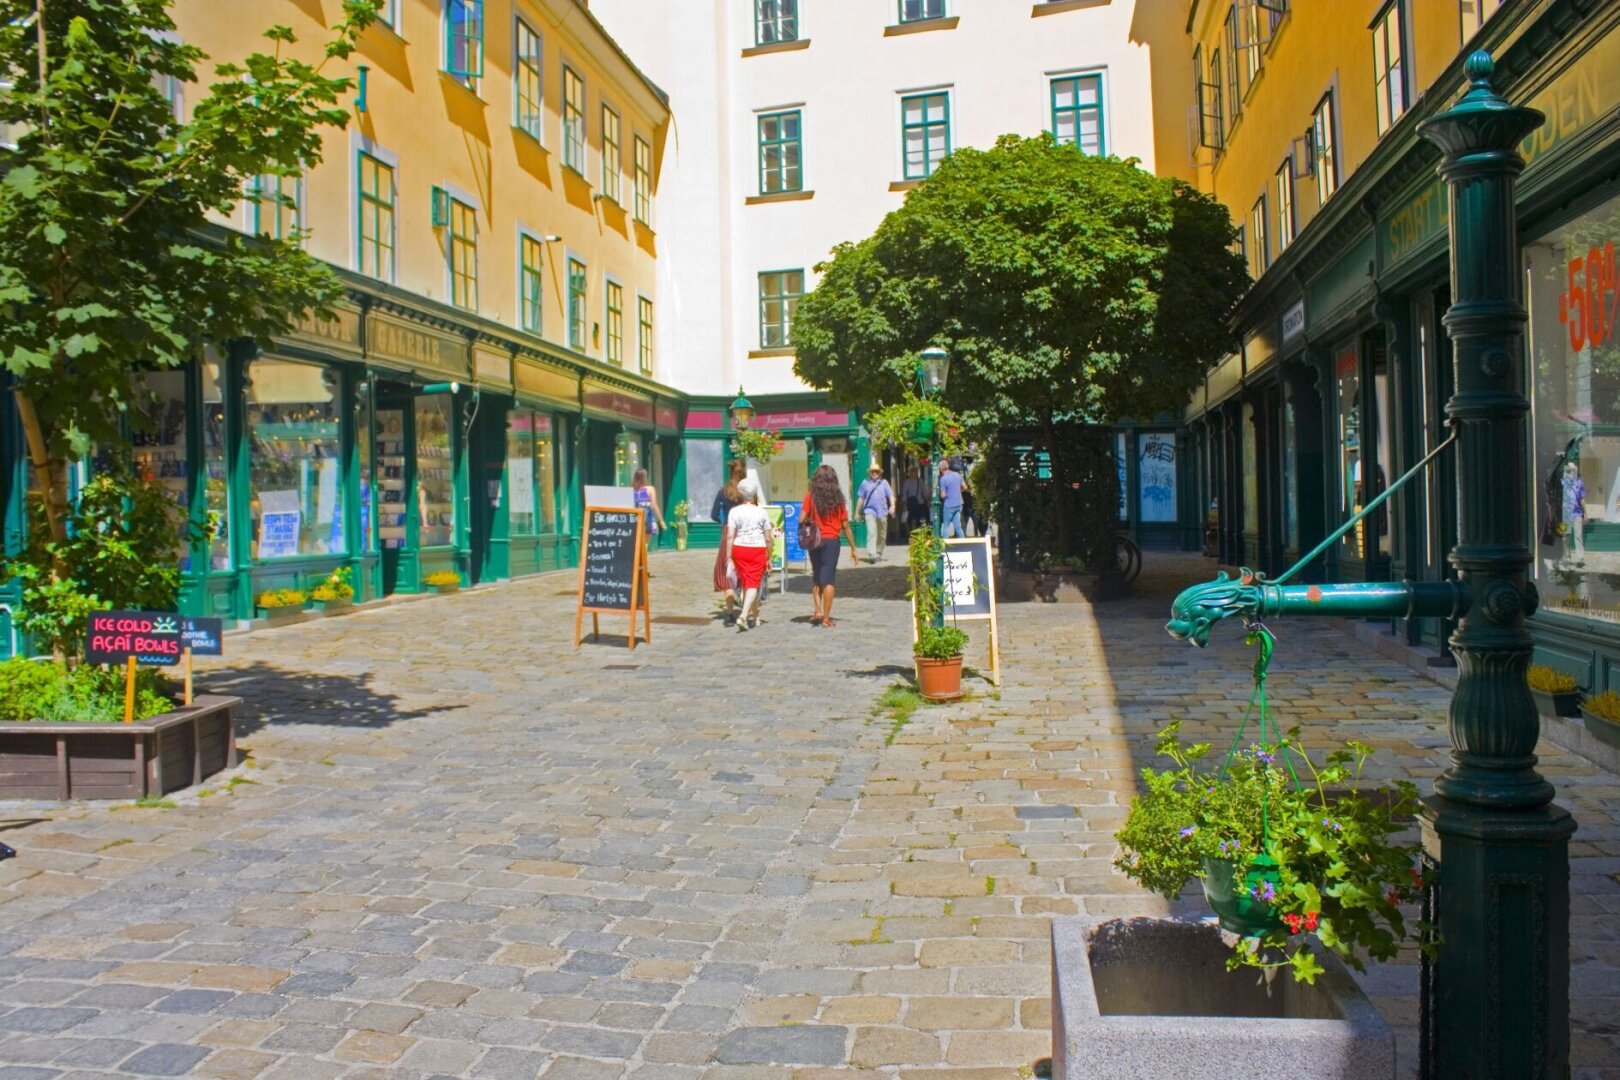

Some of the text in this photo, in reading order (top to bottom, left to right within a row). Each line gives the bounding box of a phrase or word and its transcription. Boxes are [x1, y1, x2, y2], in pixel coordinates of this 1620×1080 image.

[377, 323, 440, 365] GALERIE
[94, 618, 152, 632] ICE COLD
[134, 637, 178, 654] BOWLS
